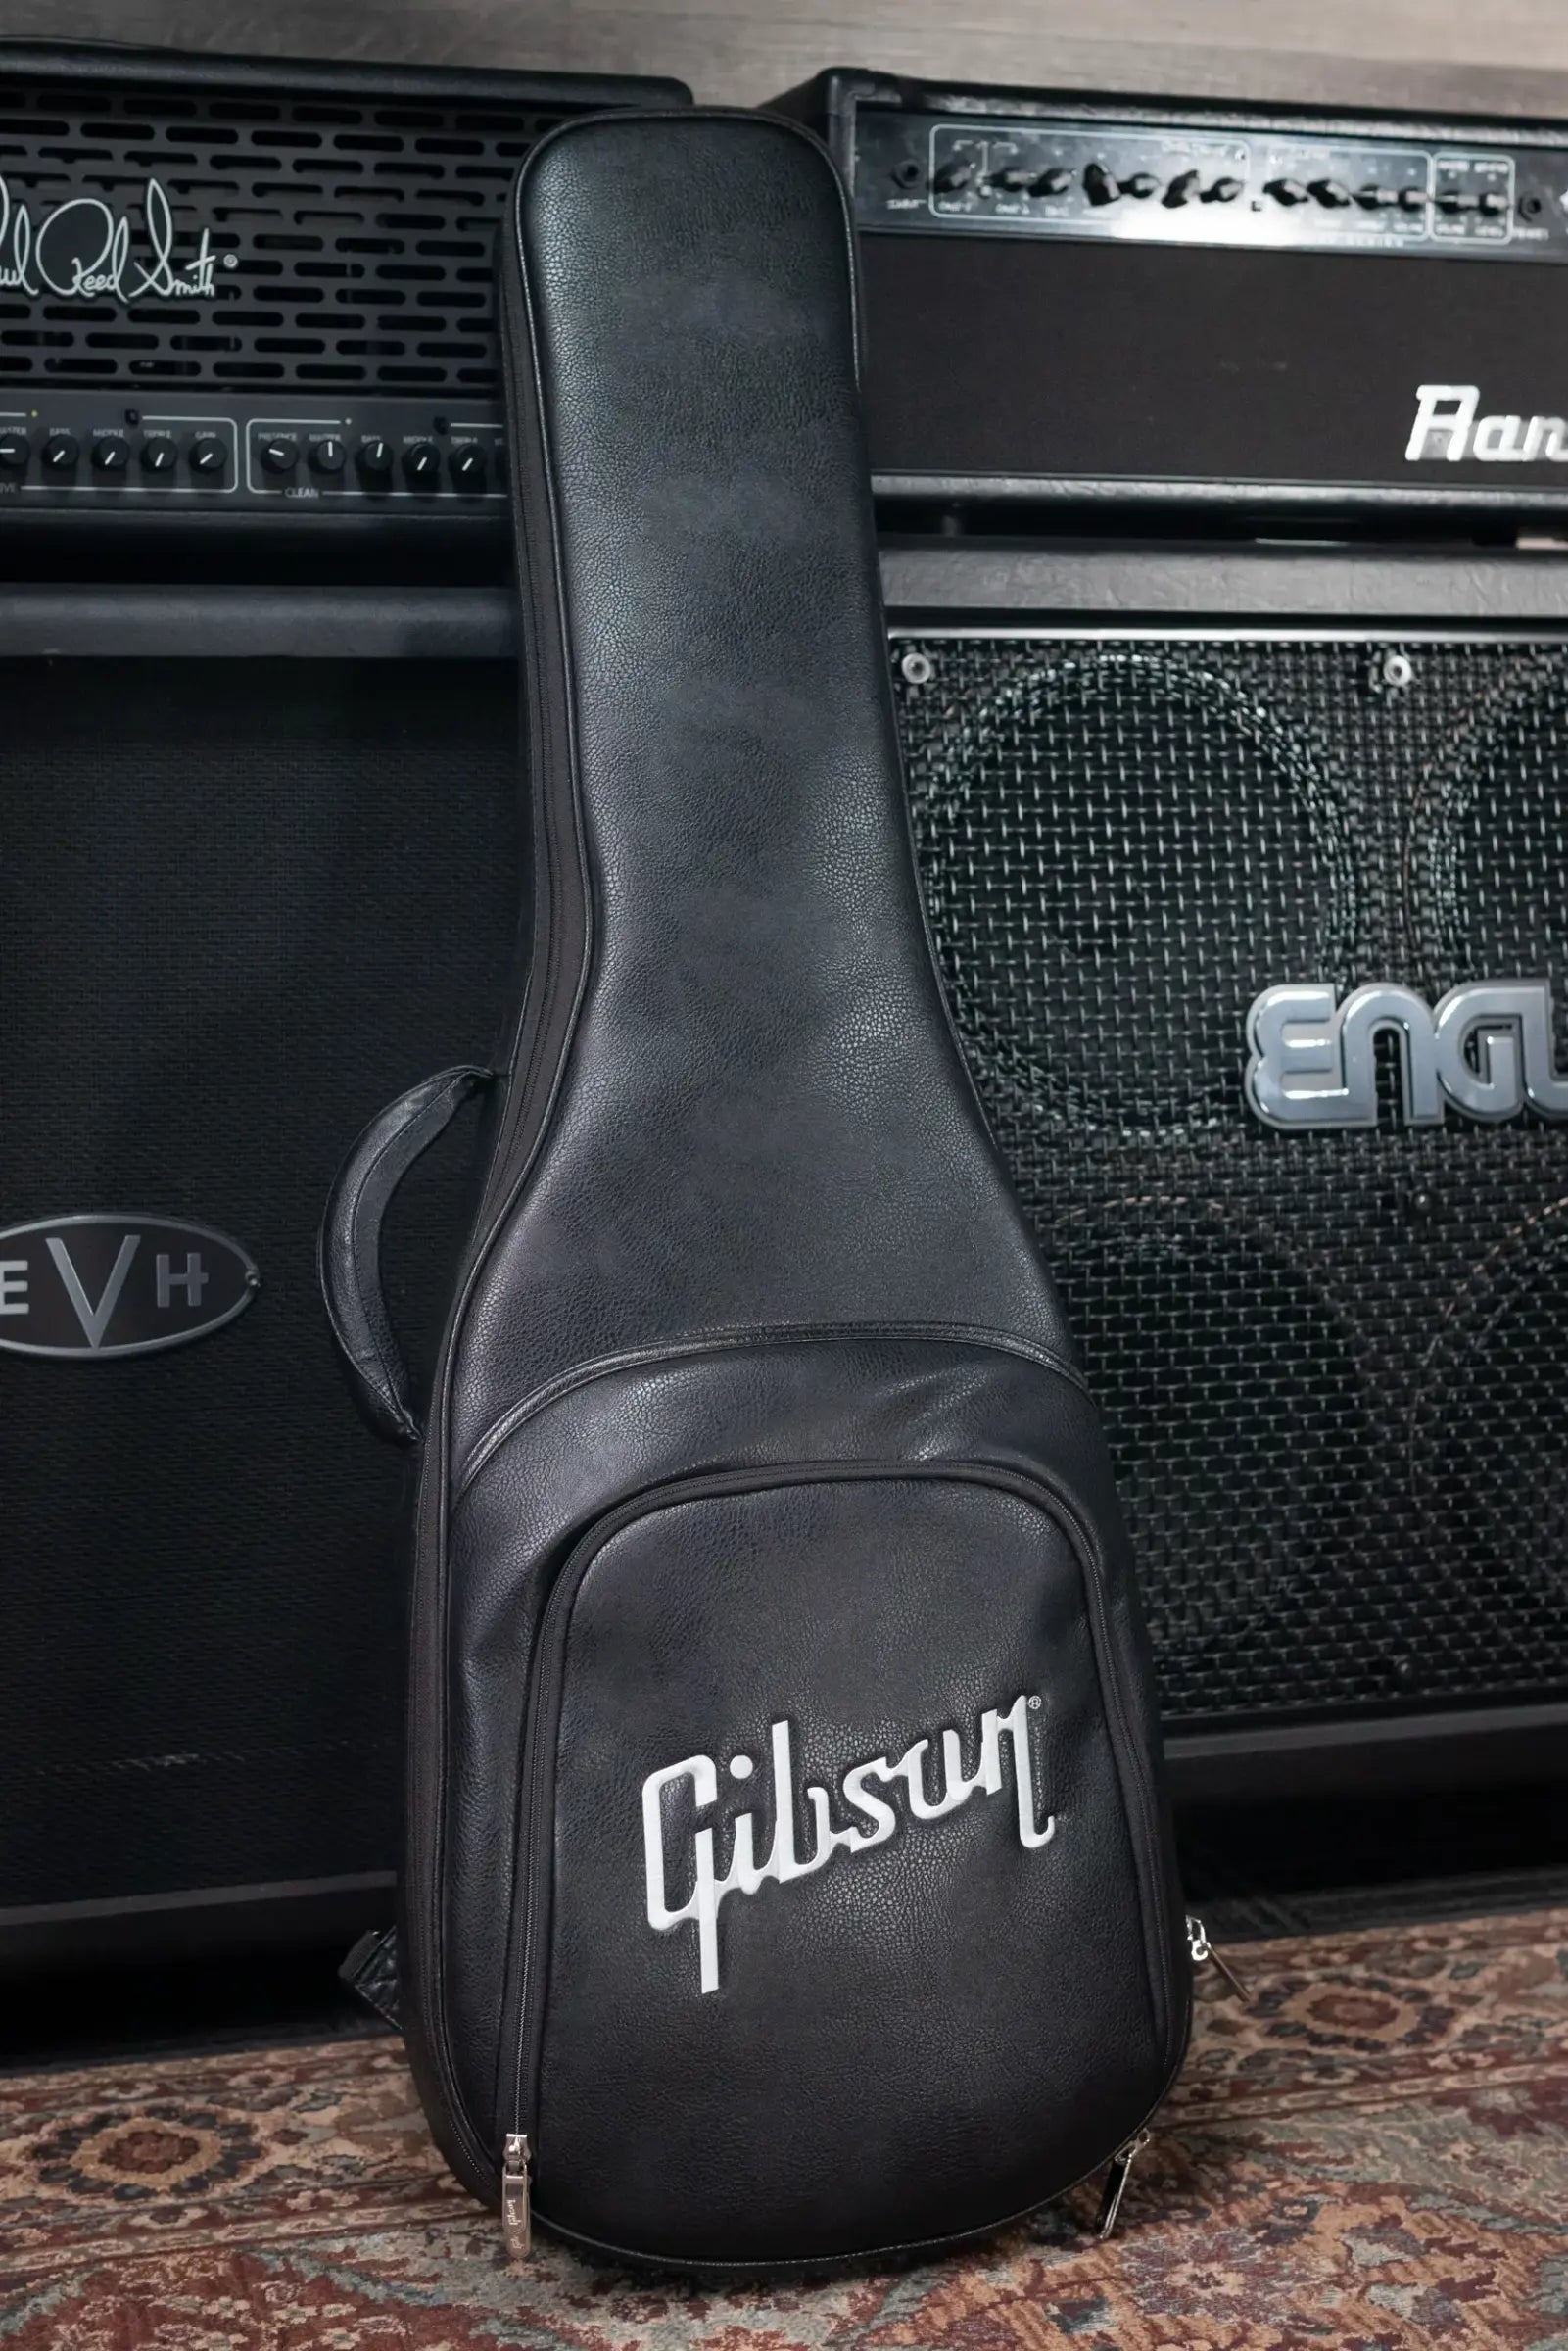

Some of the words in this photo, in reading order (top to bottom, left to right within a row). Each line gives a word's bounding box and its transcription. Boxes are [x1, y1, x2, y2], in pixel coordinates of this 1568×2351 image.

[36, 198, 128, 303] Reed
[128, 177, 215, 297] Smith
[0, 1234, 209, 1349] EVH
[642, 1695, 1055, 1994] Gibson
